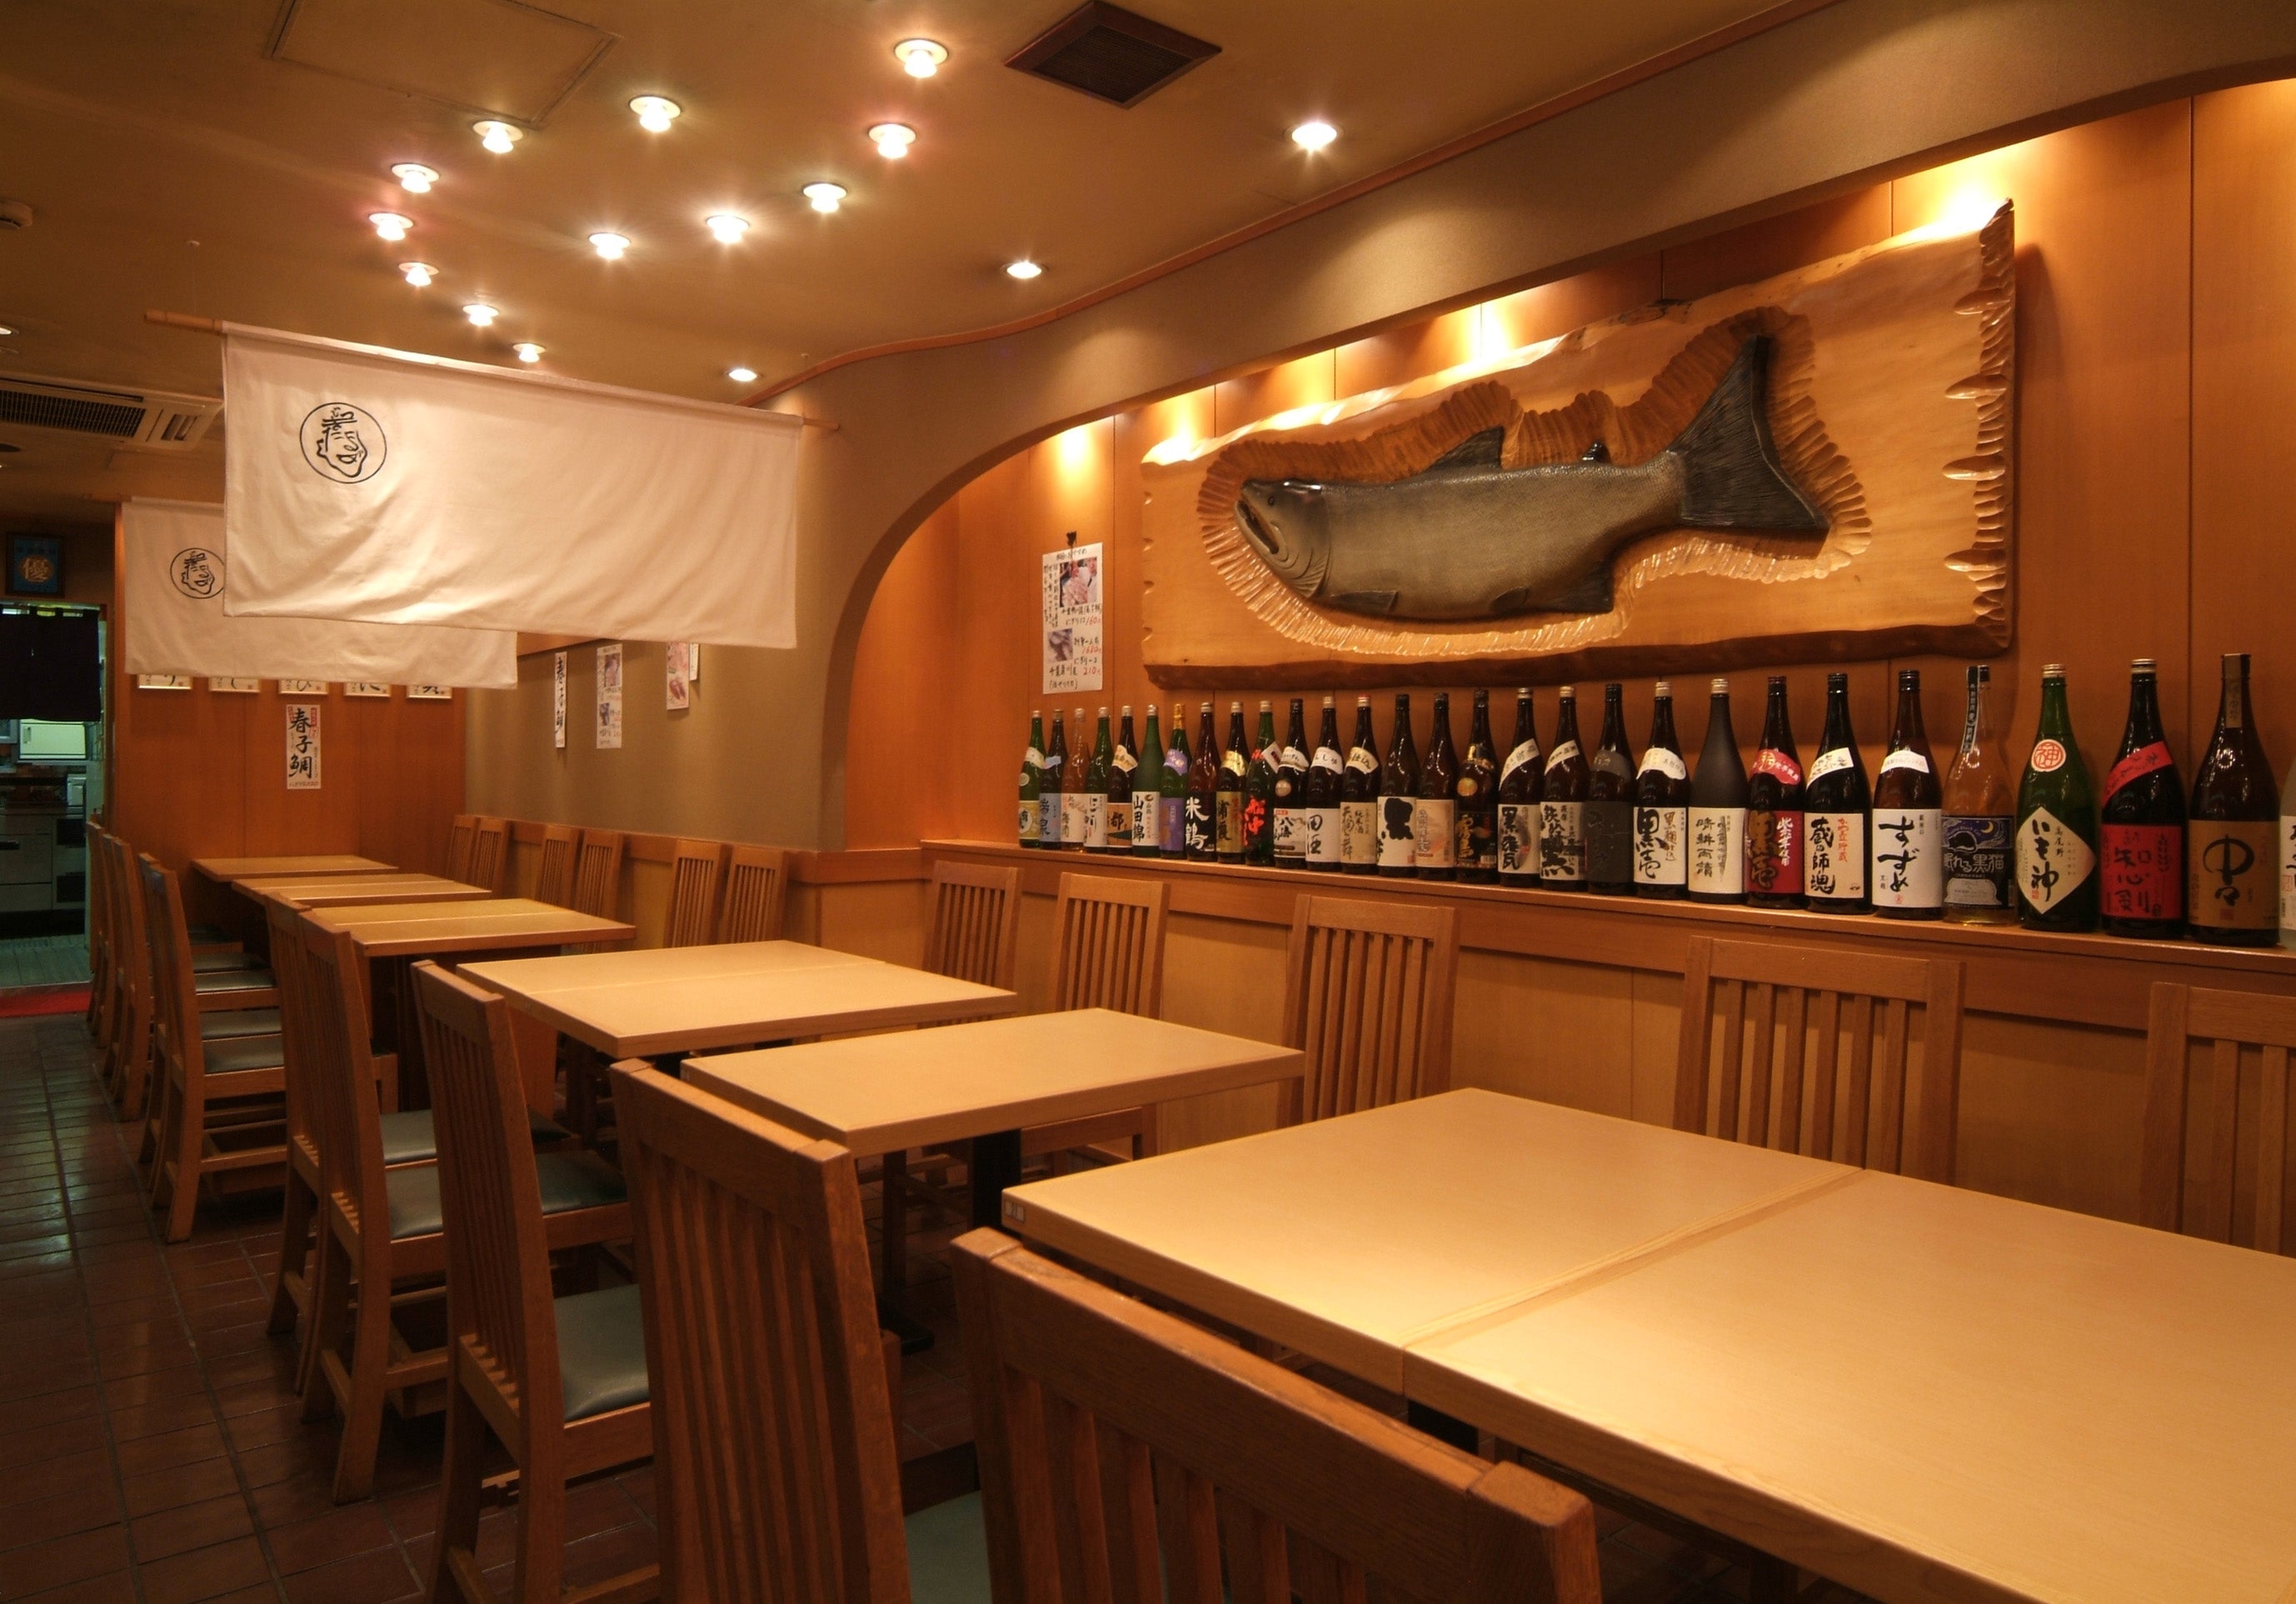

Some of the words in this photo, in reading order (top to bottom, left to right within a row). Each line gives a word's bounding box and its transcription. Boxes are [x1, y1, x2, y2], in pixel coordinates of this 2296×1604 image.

[288, 708, 312, 779] 春子鯛
[1133, 794, 1145, 843] 山田錦
[1185, 796, 1210, 849] 米鶴
[1877, 815, 1919, 892] すずめ
[1809, 817, 1836, 895] 蔵の師魂
[2031, 819, 2059, 902] いも神
